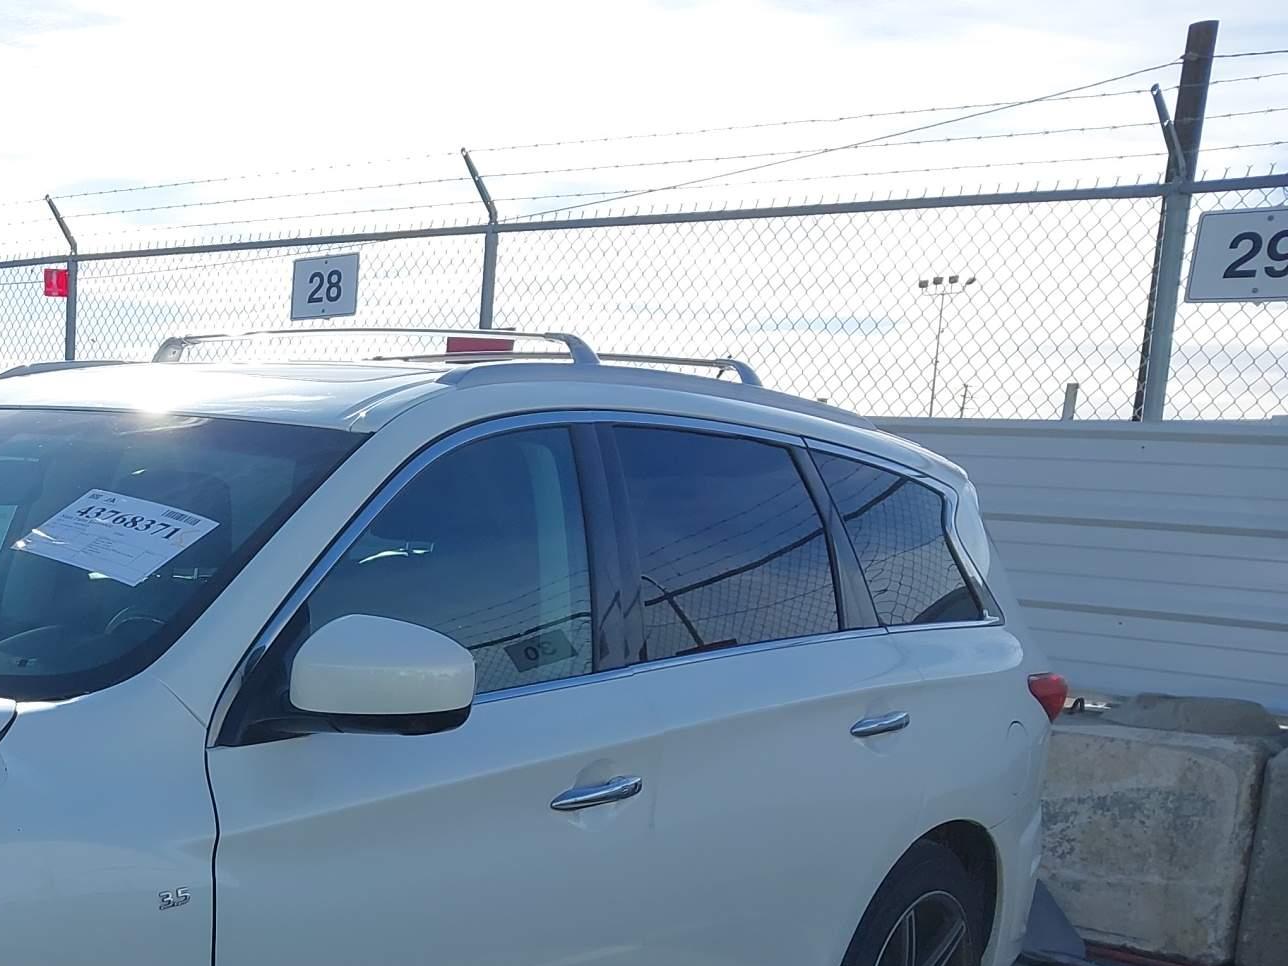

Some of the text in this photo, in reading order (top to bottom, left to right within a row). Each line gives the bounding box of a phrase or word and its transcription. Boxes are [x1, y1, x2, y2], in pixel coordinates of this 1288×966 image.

[1222, 229, 1288, 279] 29
[306, 269, 343, 304] 28
[75, 505, 183, 540] 43768371
